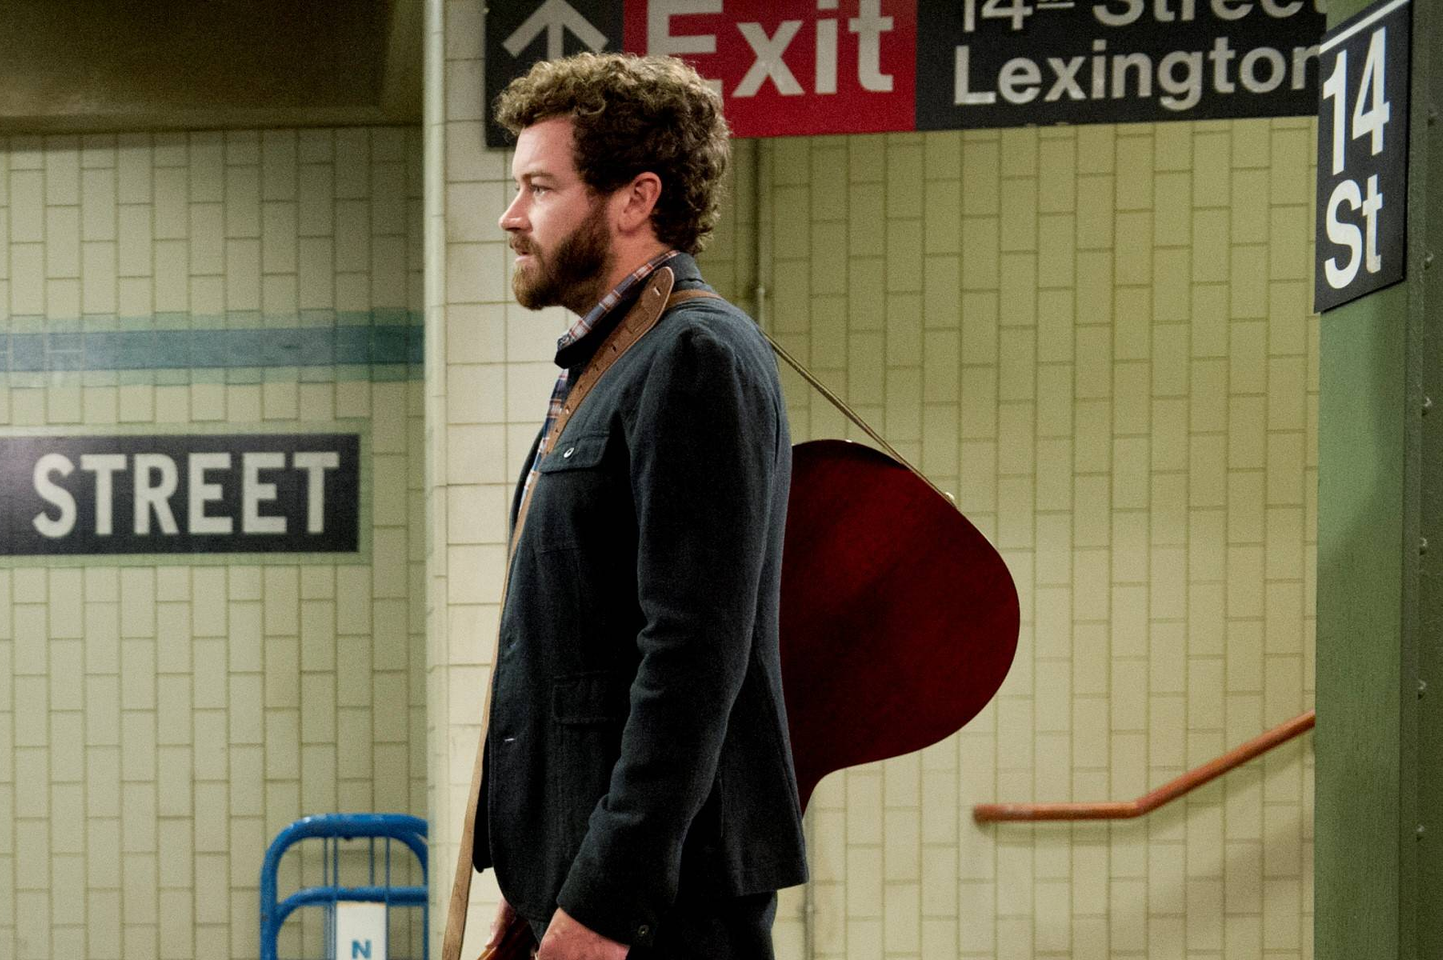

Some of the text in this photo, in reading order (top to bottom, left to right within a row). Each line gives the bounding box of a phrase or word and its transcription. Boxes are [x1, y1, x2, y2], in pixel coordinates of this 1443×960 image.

[647, 0, 895, 97] Exit
[1321, 27, 1391, 176] 14
[1323, 174, 1383, 290] St
[31, 451, 340, 538] STREET
